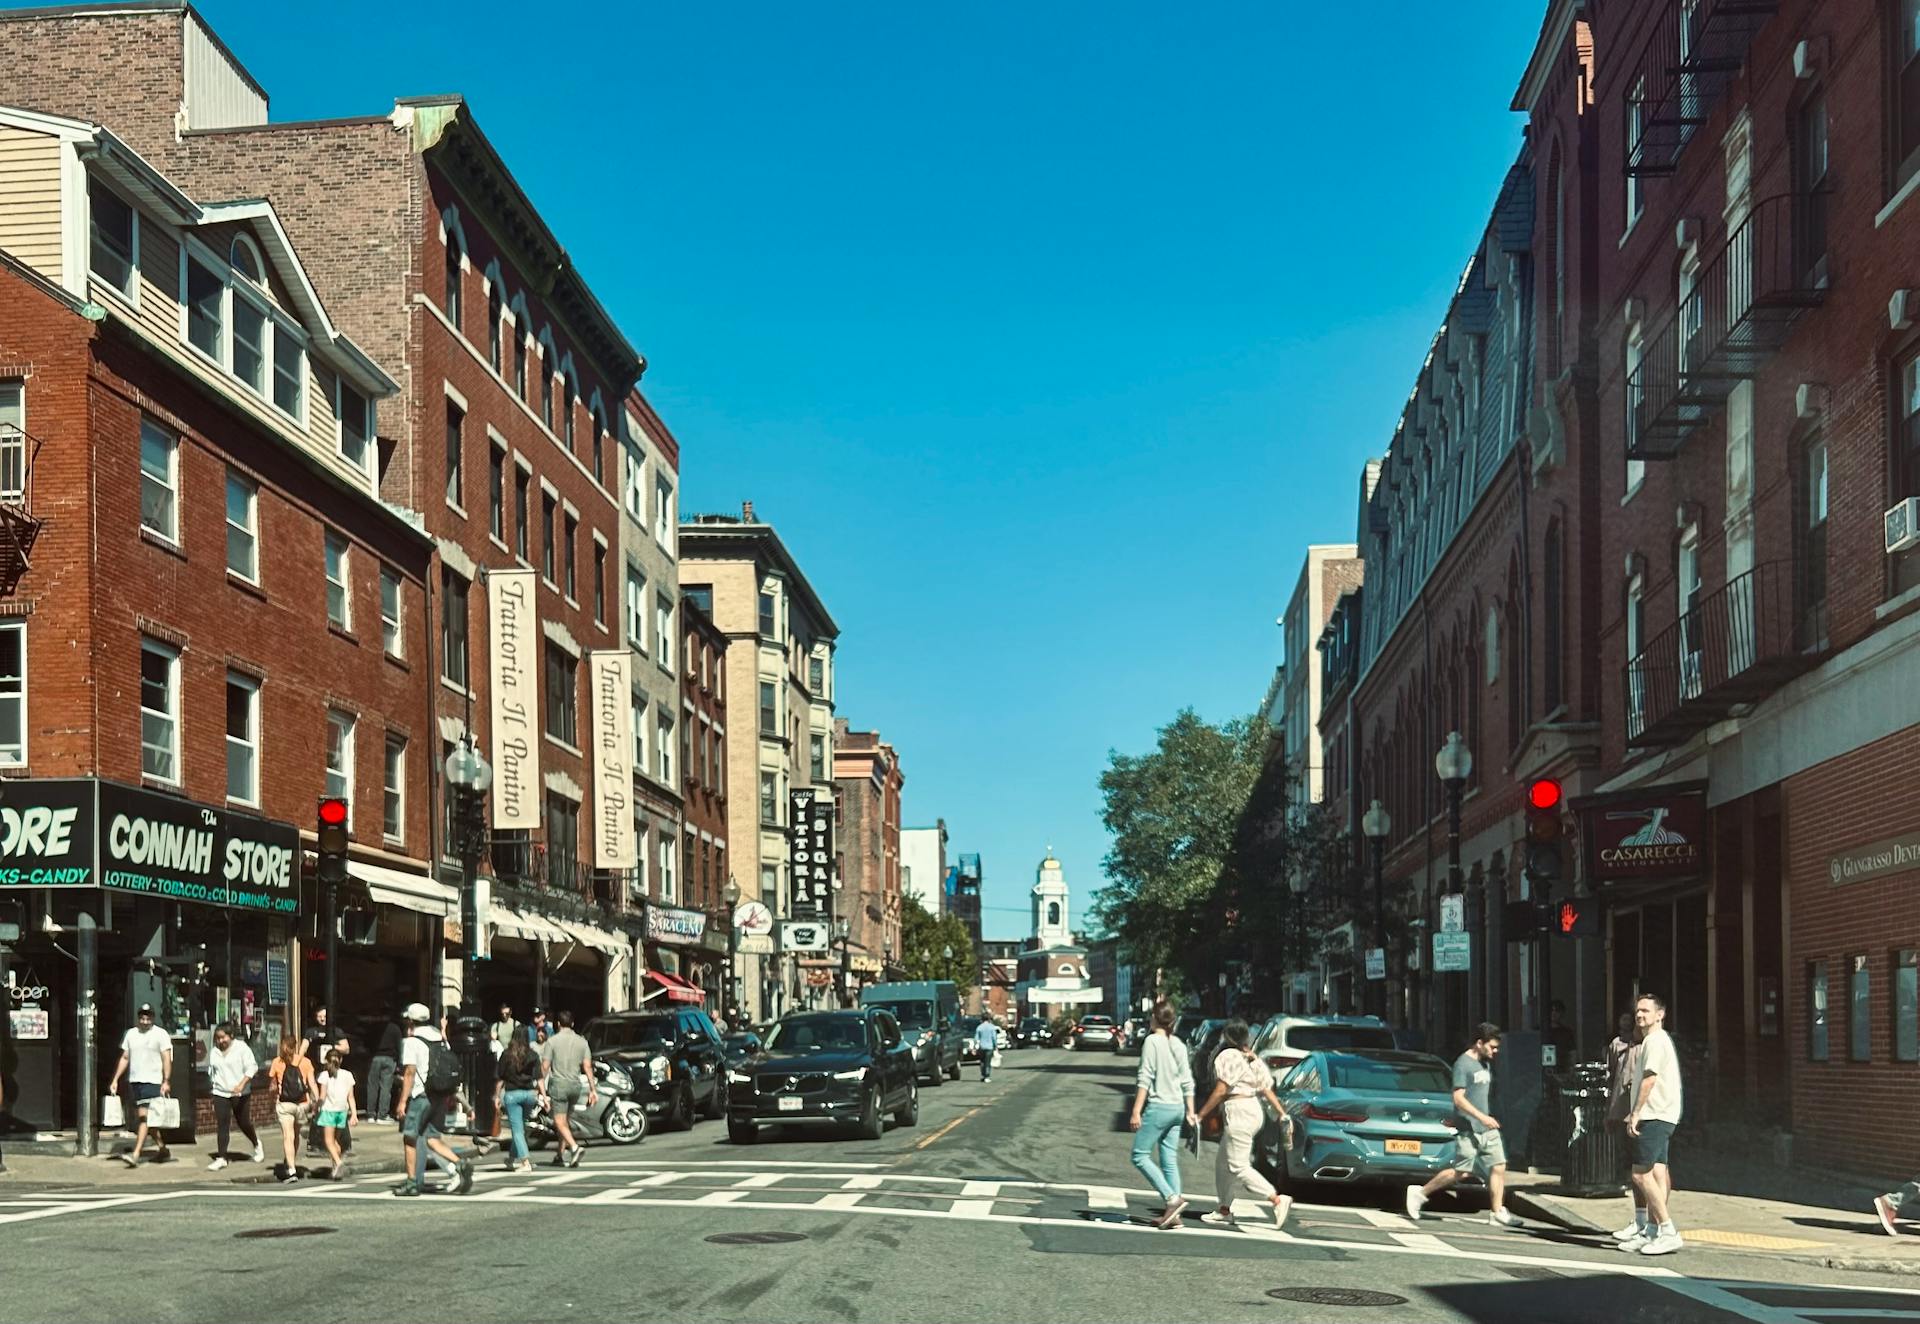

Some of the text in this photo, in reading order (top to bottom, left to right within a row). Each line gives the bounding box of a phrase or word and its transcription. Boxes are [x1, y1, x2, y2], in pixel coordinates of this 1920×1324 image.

[500, 581, 525, 689] Trattoria
[601, 660, 623, 750] Trattoria
[503, 738, 528, 818] Panino
[109, 814, 293, 888] CONNAH STORE
[604, 791, 625, 858] Panino
[794, 798, 810, 902] VITTORIA
[1600, 845, 1697, 861] CASARECCE
[813, 819, 828, 912] SIGARI
[648, 912, 704, 936] SARACENO
[10, 986, 49, 1002] open
